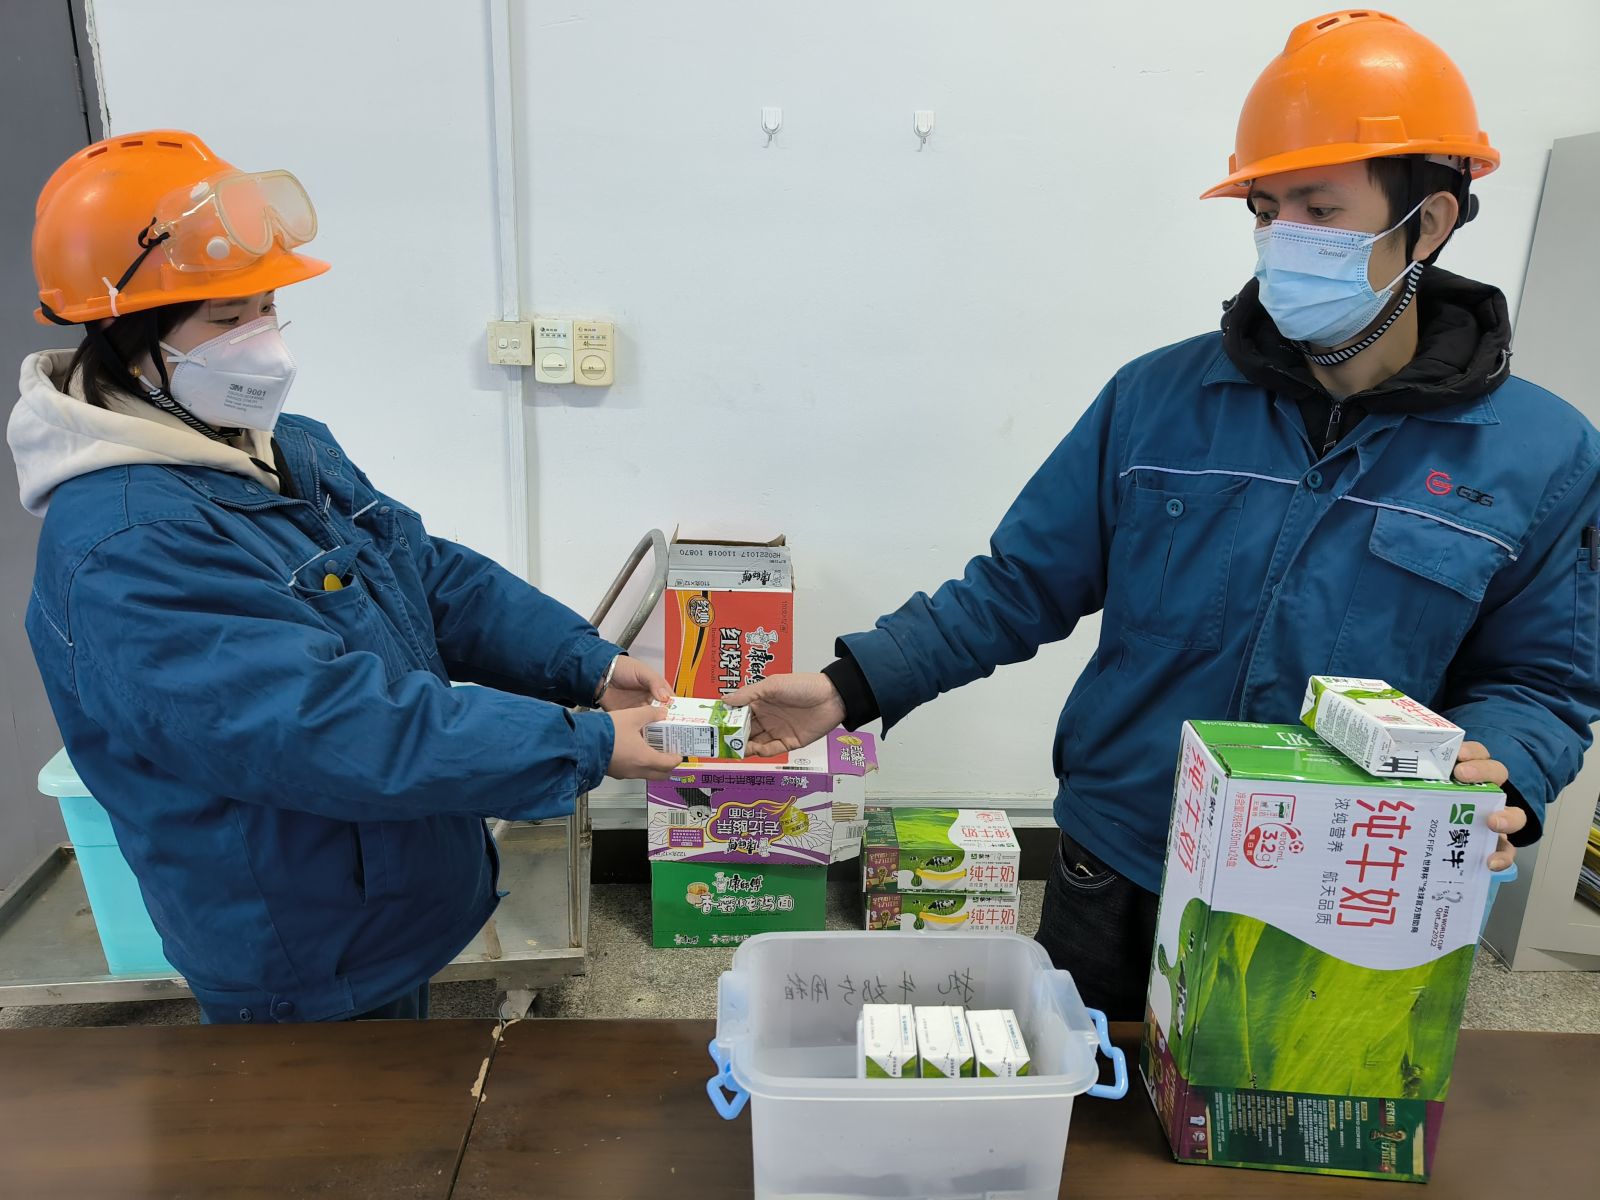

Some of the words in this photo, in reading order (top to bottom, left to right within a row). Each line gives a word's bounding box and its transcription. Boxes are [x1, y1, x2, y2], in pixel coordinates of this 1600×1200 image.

[229, 384, 243, 392] 3M
[246, 387, 267, 397] 9001
[718, 627, 742, 697] 红烧牛
[701, 774, 776, 784] 老坛酸菜牛肉面
[728, 808, 768, 819] 牛肉面
[1178, 746, 1207, 873] 纯牛奶
[716, 819, 782, 835] 老坛酸菜
[1326, 797, 1351, 853] 浓纯营养
[1428, 819, 1438, 838] 2022
[1256, 830, 1278, 862] 3.2g
[1424, 839, 1434, 858] FIFA
[1442, 828, 1469, 869] 蒙牛
[1336, 799, 1415, 927] 纯牛奶
[969, 865, 1015, 883] 纯牛奶
[697, 895, 795, 914] 香菇炖鸡面
[1315, 871, 1339, 925] 航天品质
[970, 908, 1015, 925] 纯牛奶
[1439, 919, 1448, 939] WORLD
[1436, 939, 1444, 951] CUP
